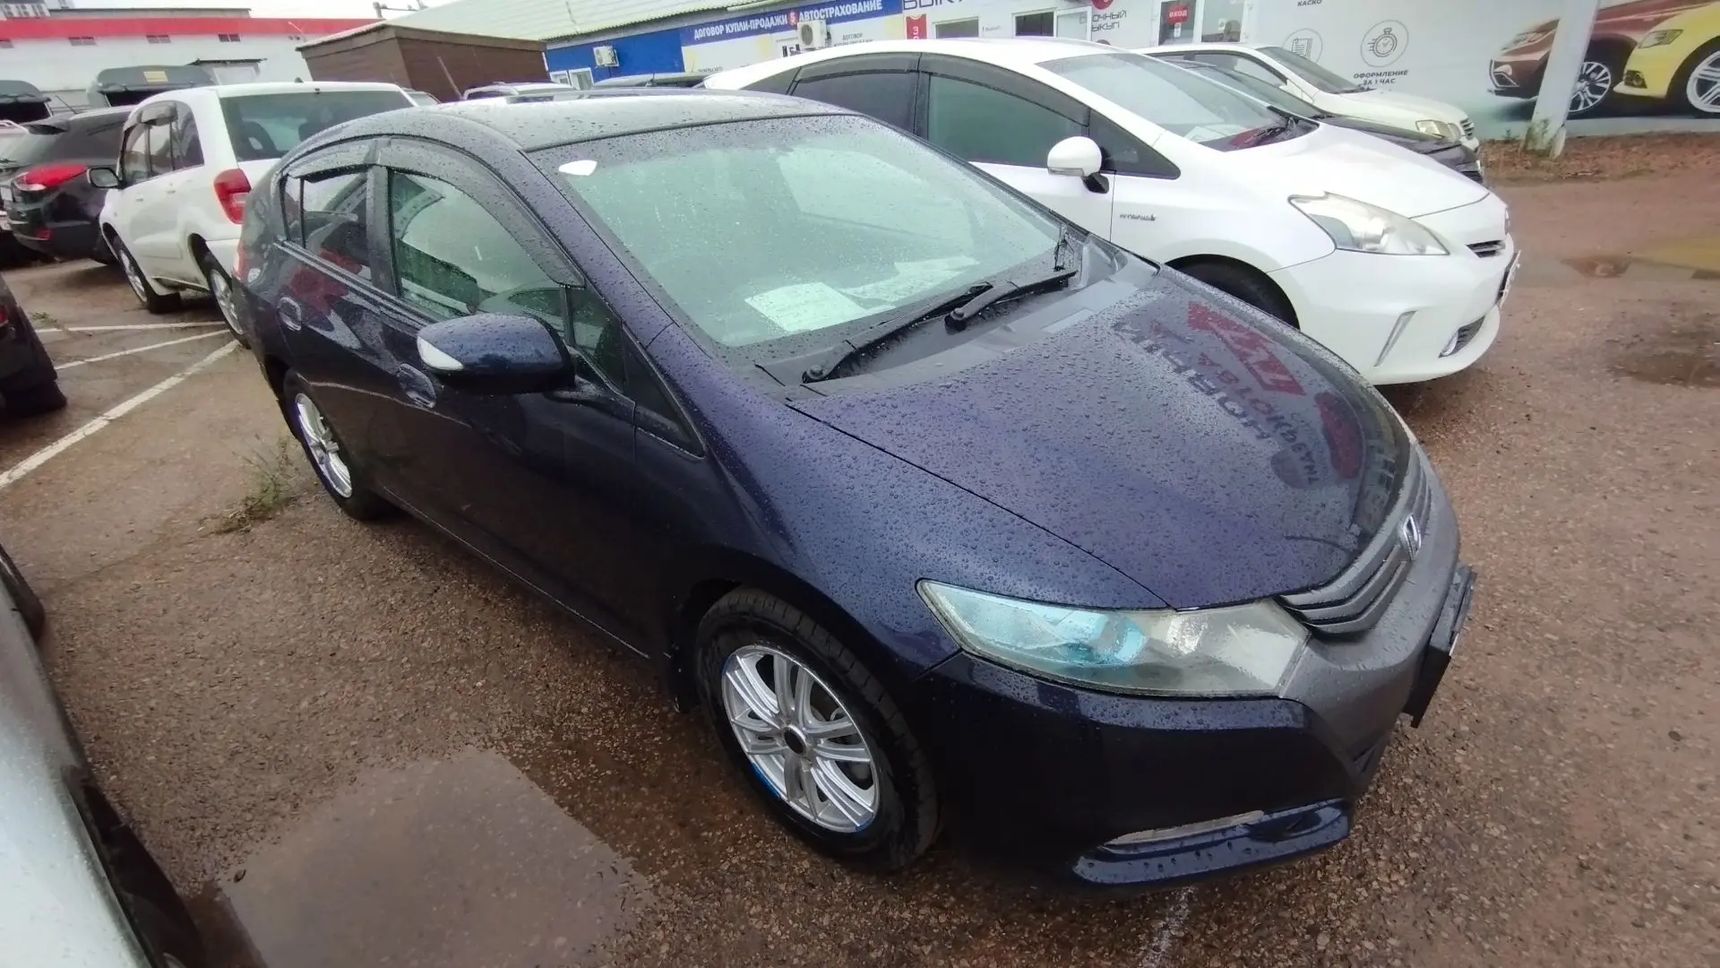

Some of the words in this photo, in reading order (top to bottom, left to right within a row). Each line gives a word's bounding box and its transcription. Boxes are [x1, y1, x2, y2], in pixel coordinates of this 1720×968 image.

[694, 25, 724, 40] ДОГОВОР
[725, 14, 788, 34] КУПЛИ-ПРОДАЖИ
[799, 0, 883, 21] АВТОСТРАХОВАНИЕ
[1353, 69, 1408, 79] ОФОРМЛЕНИЕ
